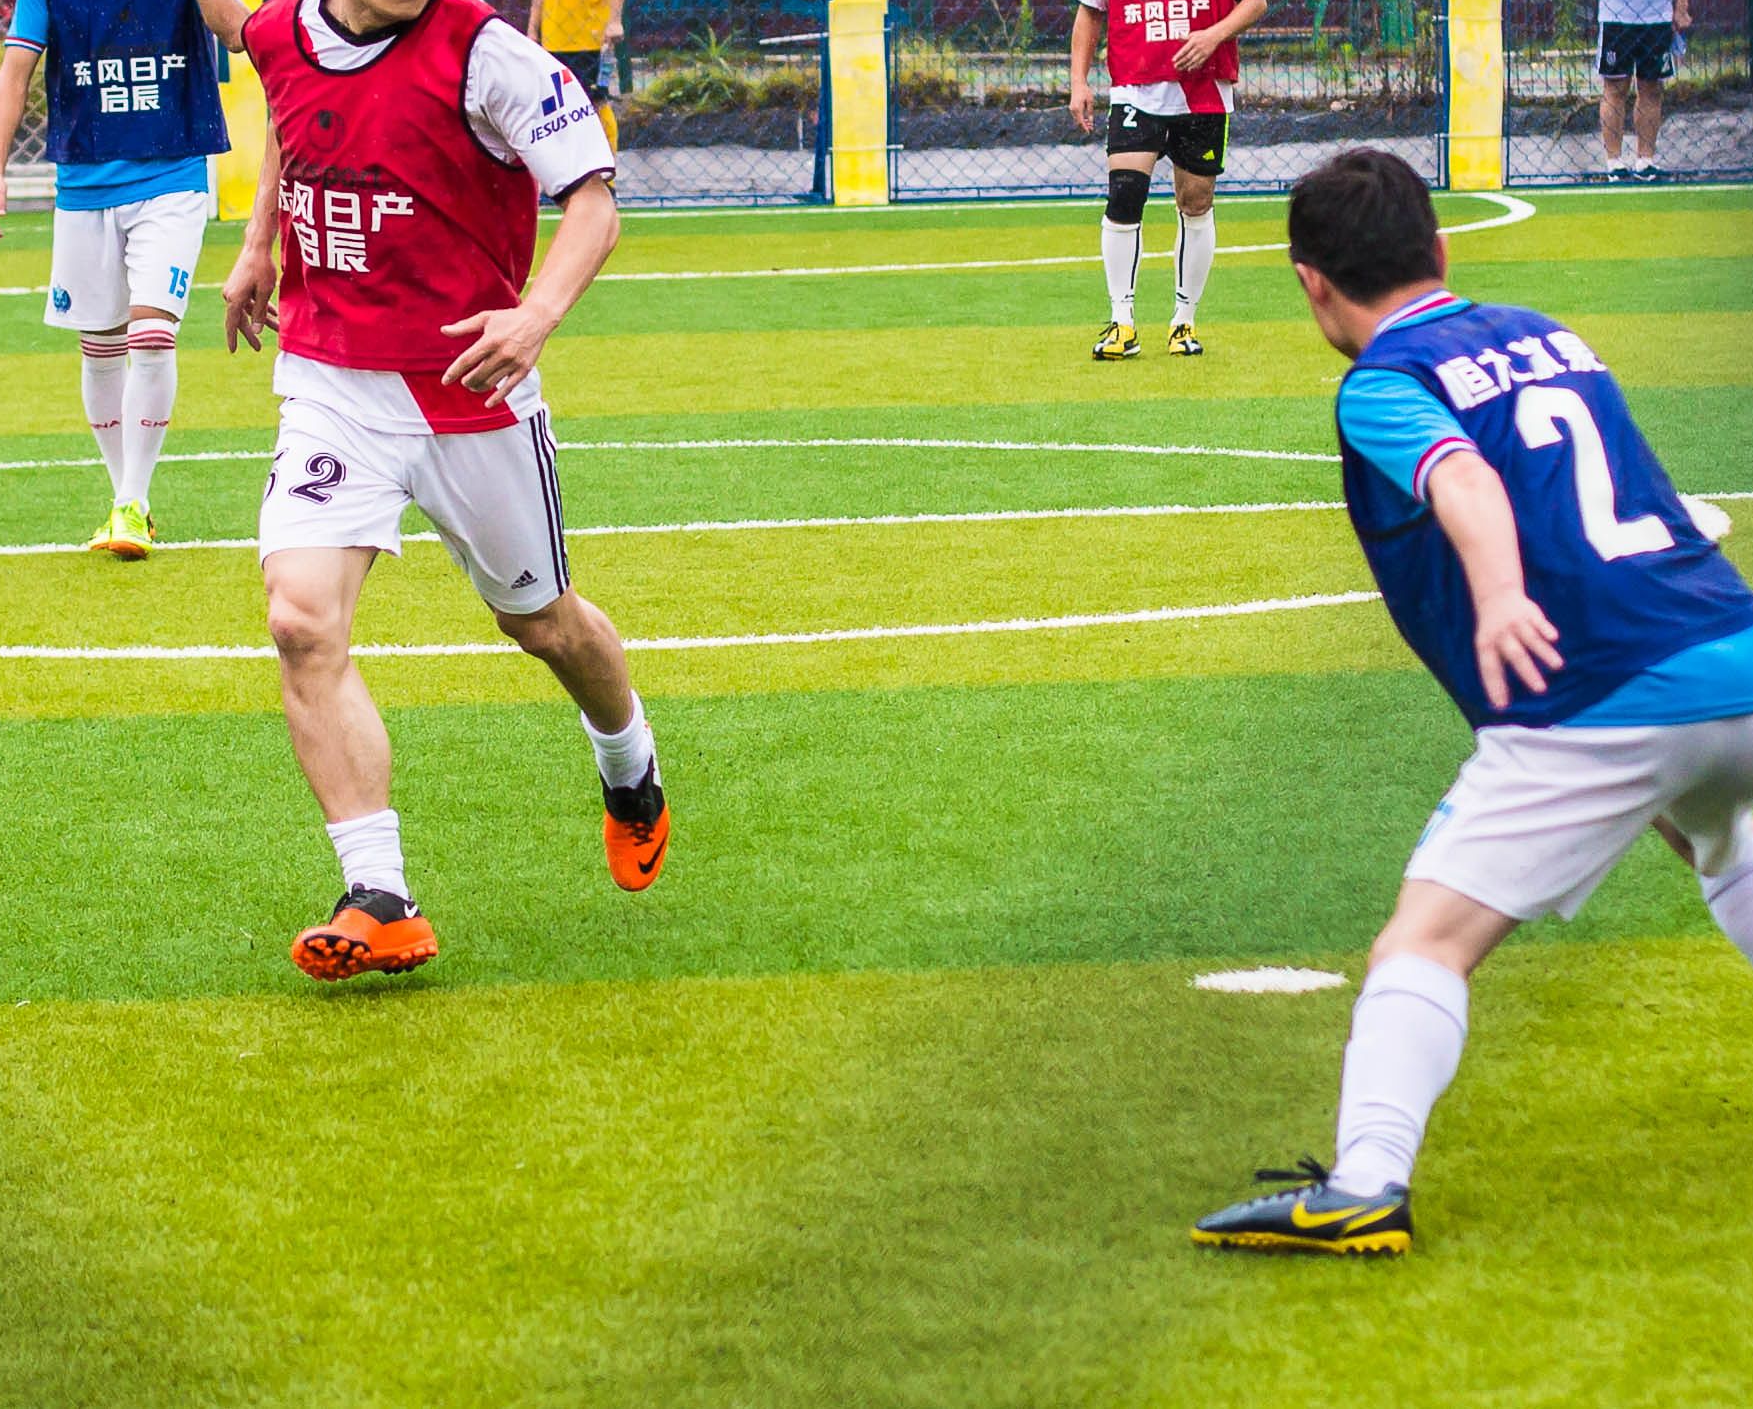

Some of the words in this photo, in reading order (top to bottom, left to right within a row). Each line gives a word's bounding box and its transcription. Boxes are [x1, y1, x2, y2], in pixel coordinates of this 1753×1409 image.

[1145, 19, 1191, 42] 启辰
[73, 54, 187, 86] 东风日产
[100, 84, 160, 113] 启辰
[530, 114, 568, 144] JESUS
[1122, 107, 1137, 128] 2
[292, 221, 370, 273] 启辰
[169, 266, 189, 299] 15
[1515, 385, 1677, 561] 2
